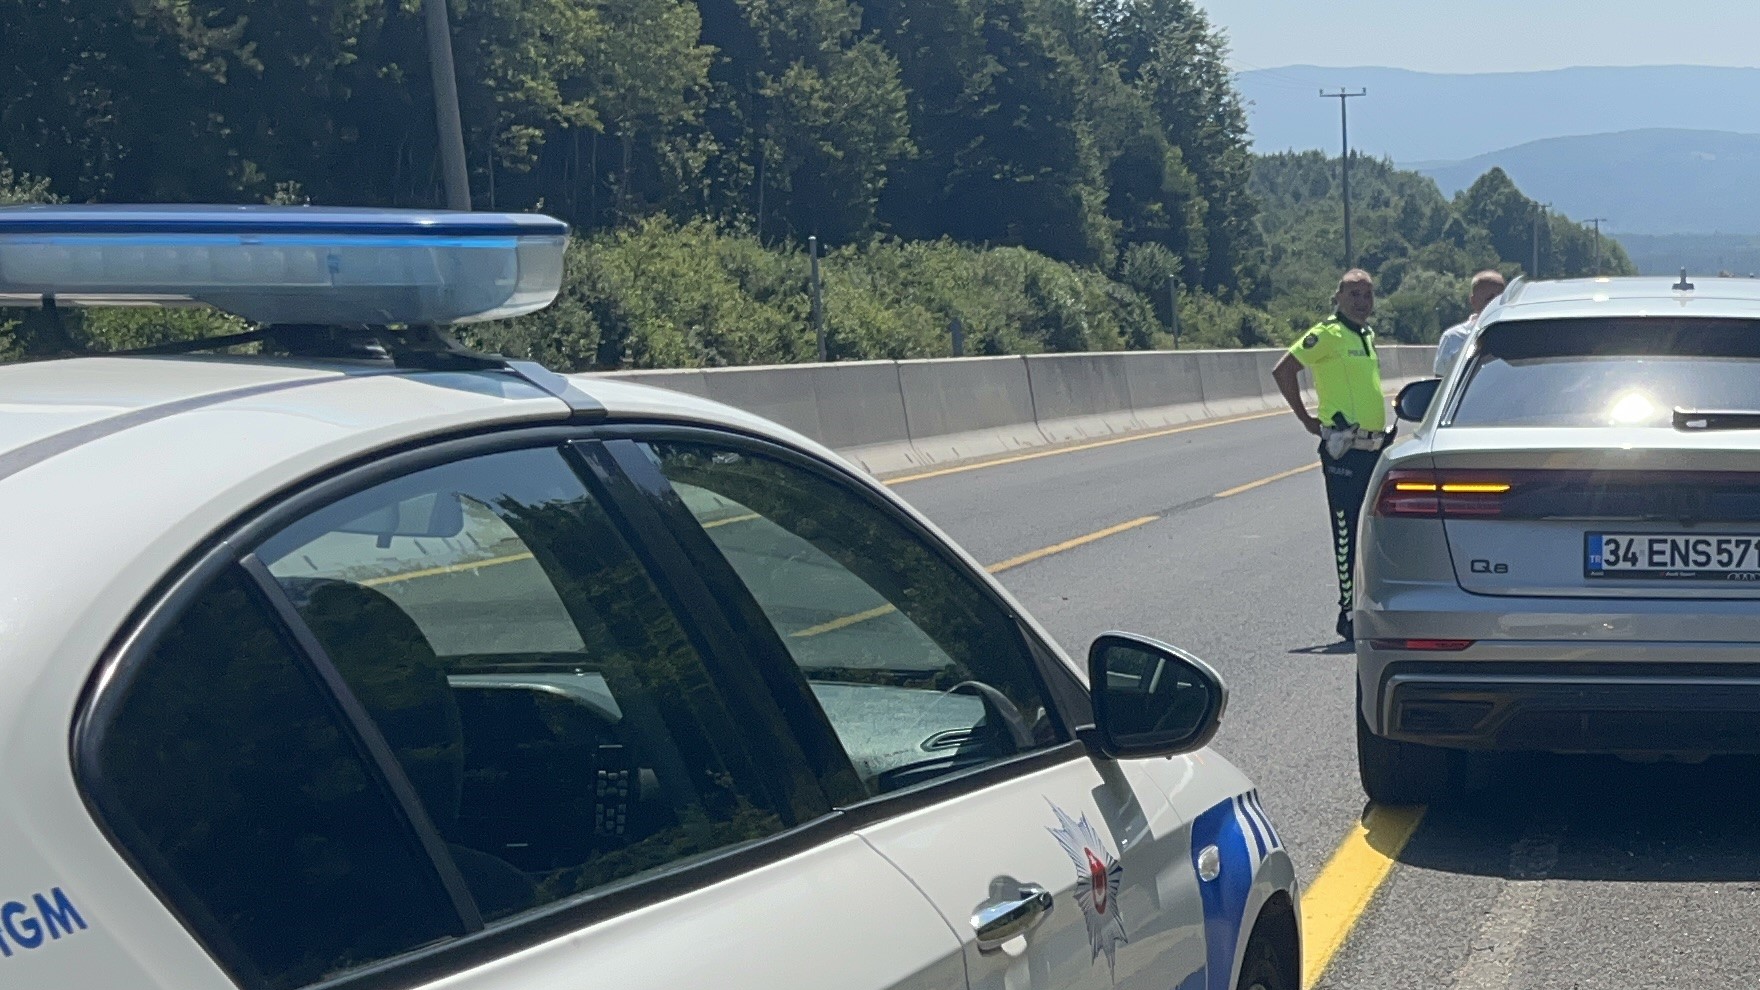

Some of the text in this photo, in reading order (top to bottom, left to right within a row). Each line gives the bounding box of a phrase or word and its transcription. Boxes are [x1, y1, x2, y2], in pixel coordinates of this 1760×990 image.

[1590, 555, 1601, 563] TR
[1604, 538, 1638, 567] 34
[1648, 538, 1712, 568] ENS
[1471, 559, 1508, 574] Q8
